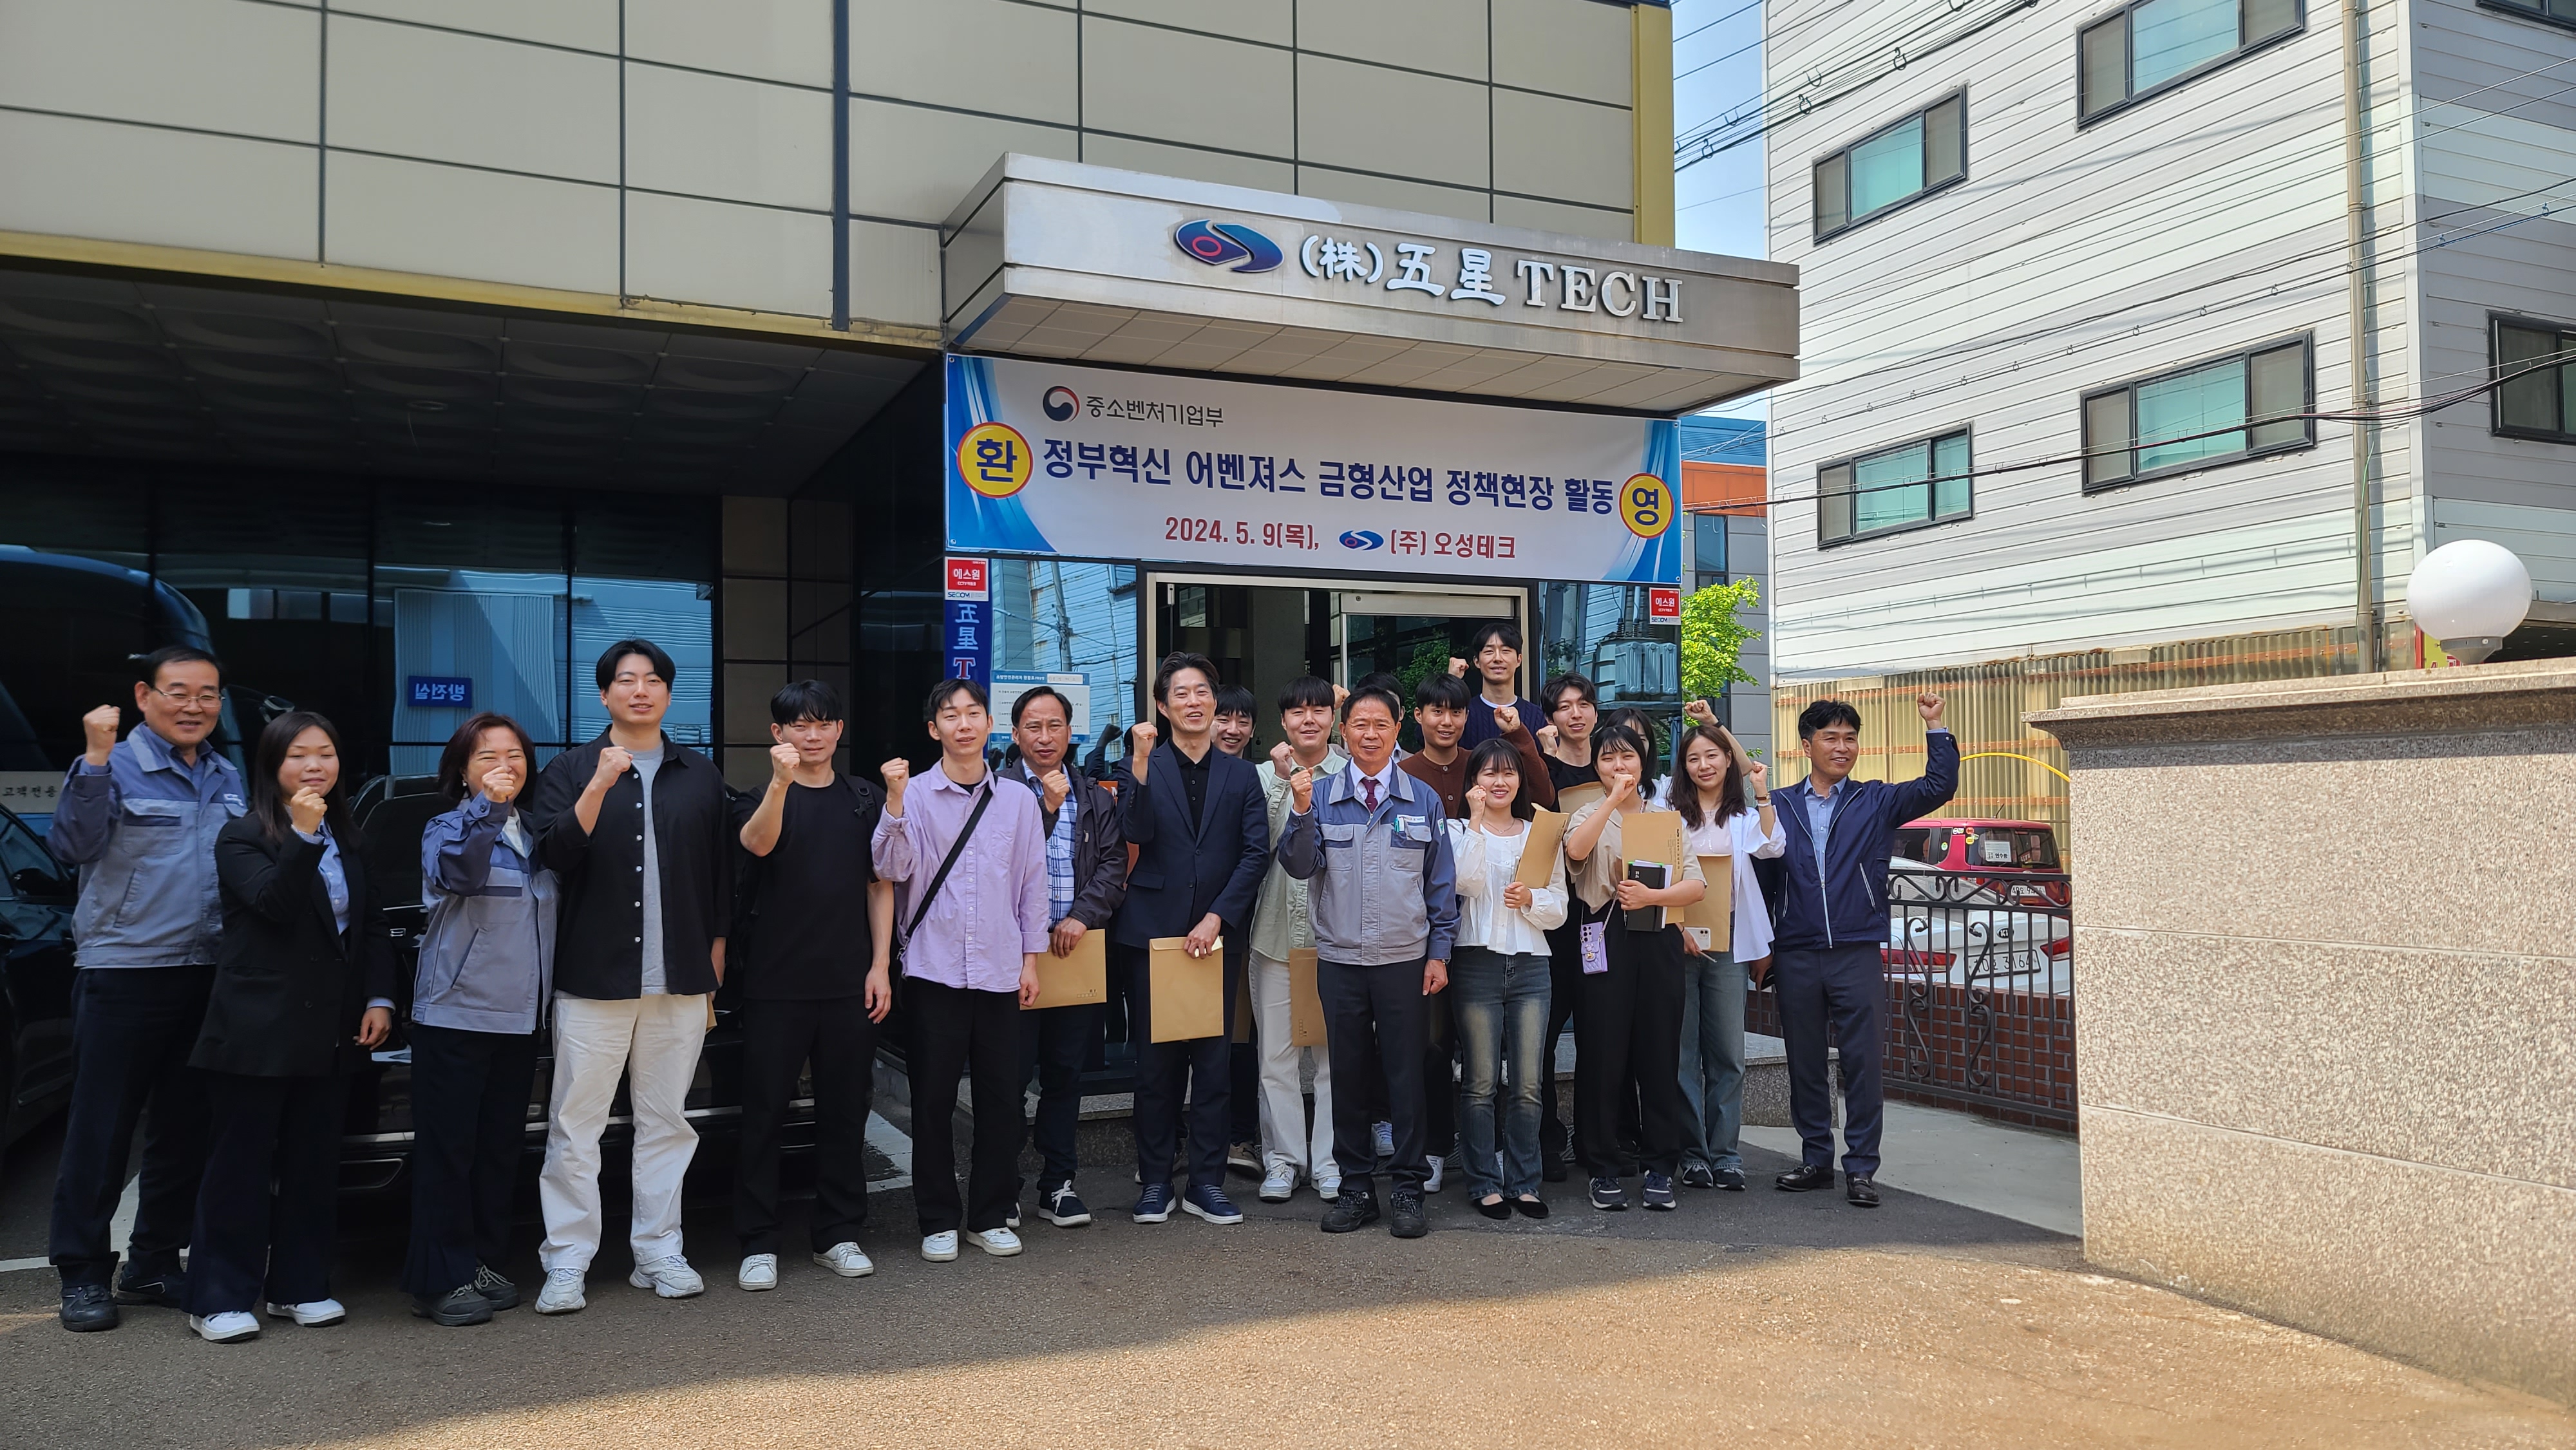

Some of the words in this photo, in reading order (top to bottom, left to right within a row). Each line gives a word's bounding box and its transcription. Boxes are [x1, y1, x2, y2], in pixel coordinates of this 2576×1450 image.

[1517, 259, 1684, 323] TECH
[1086, 395, 1224, 428] 중소벤처기업부
[976, 438, 1018, 483] 환
[1043, 438, 1171, 485] 정부혁신
[1186, 451, 1306, 493] 어벤져스
[1318, 460, 1433, 503] 금형산업
[1445, 469, 1555, 511] 정책현장
[1564, 478, 1614, 515] 활동
[1632, 487, 1660, 526] 영
[1165, 516, 1228, 543] 2024.
[1236, 522, 1255, 545] 5.
[1263, 522, 1319, 551] 9(목),
[1391, 529, 1426, 556] (주)
[1434, 532, 1515, 558] 오성테크
[953, 569, 980, 580] 에스원
[1655, 598, 1675, 607] 에스원
